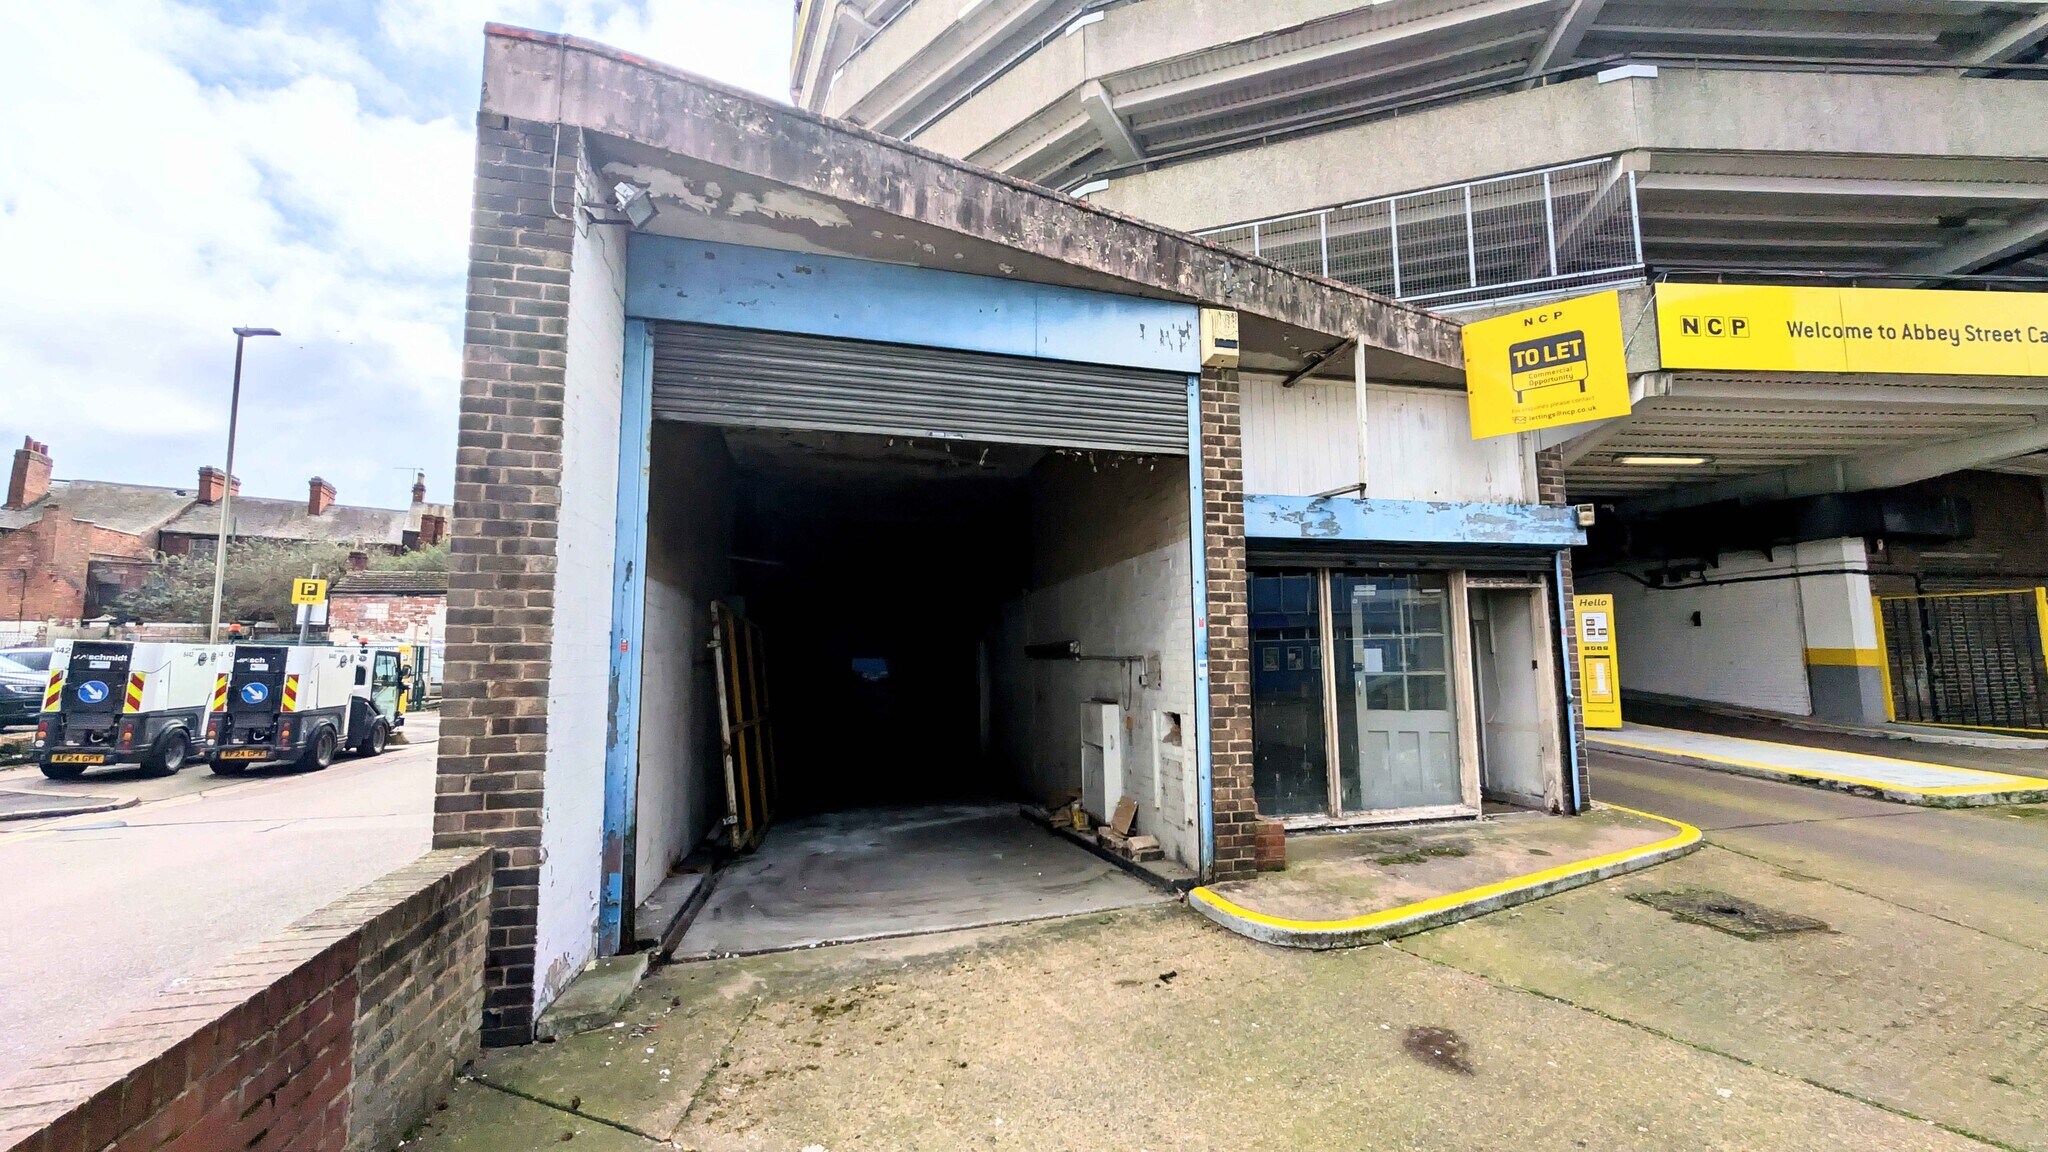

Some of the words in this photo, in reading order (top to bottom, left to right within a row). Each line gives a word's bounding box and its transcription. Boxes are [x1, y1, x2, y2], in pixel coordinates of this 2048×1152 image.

[1523, 312, 1563, 327] NCP
[1682, 317, 1746, 336] NCP
[1786, 320, 1873, 339] Welcome
[1877, 324, 1897, 340] to
[1901, 323, 1960, 347] Abbey
[1964, 324, 2023, 342] Street
[1513, 347, 1540, 368] TO
[1543, 338, 1582, 363] LET
[1528, 366, 1573, 379] Commercial
[1528, 373, 1574, 387] Opportunity
[1528, 405, 1597, 420] lettings@ncp.co.uk
[1579, 599, 1608, 607] Hello
[88, 653, 128, 662] schmidt
